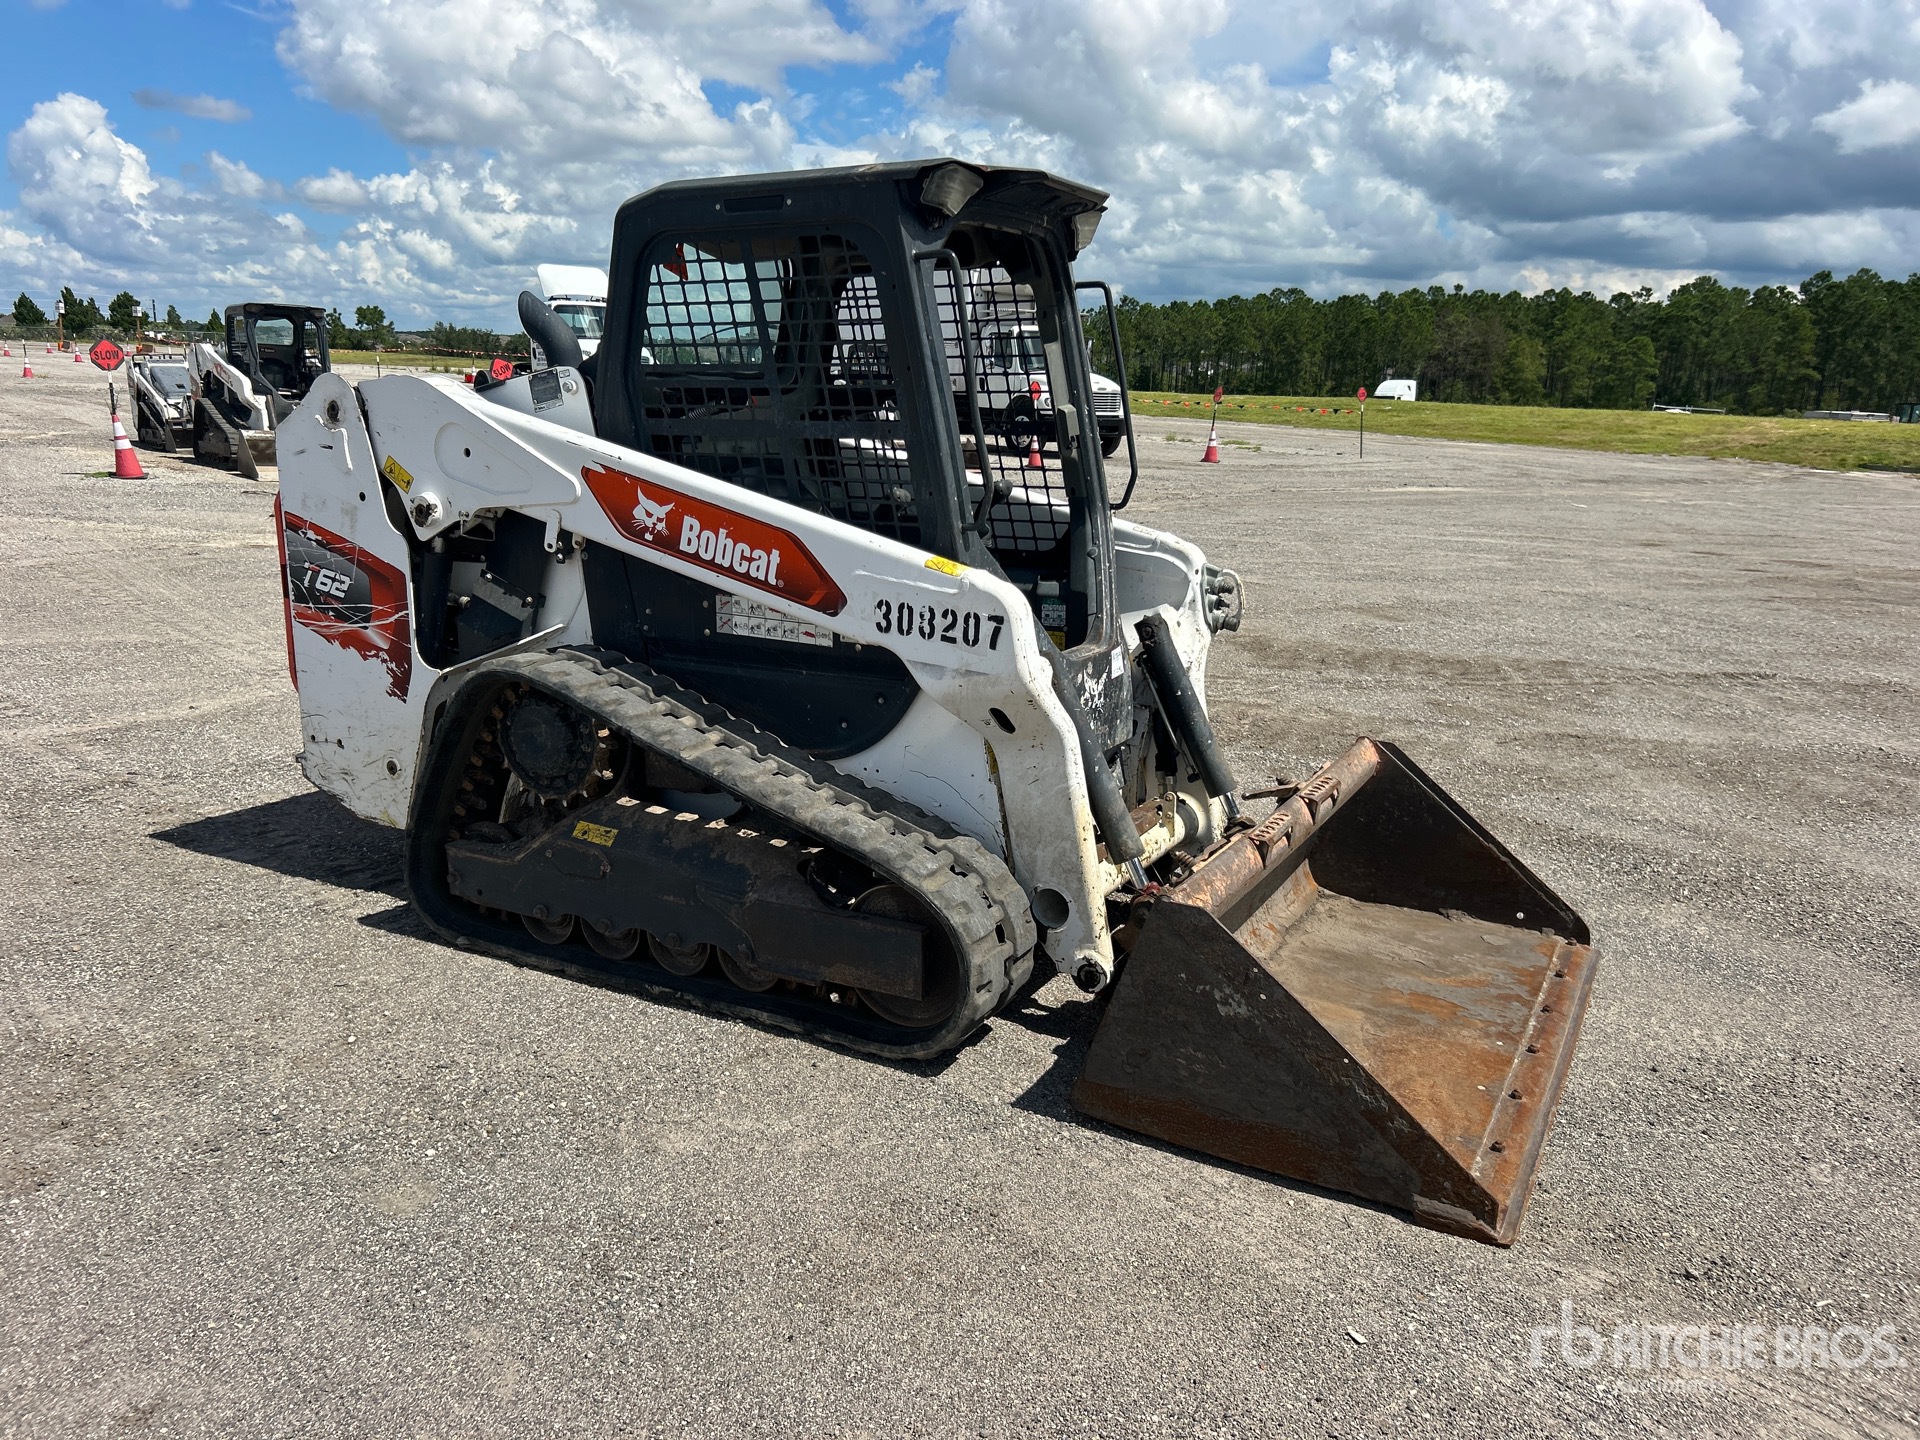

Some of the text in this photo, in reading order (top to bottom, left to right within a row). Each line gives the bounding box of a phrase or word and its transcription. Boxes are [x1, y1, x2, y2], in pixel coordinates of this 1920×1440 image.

[93, 350, 119, 360] SLOW
[493, 362, 511, 378] SLOW
[679, 514, 781, 586] Bobcat
[874, 599, 1005, 651] 308207
